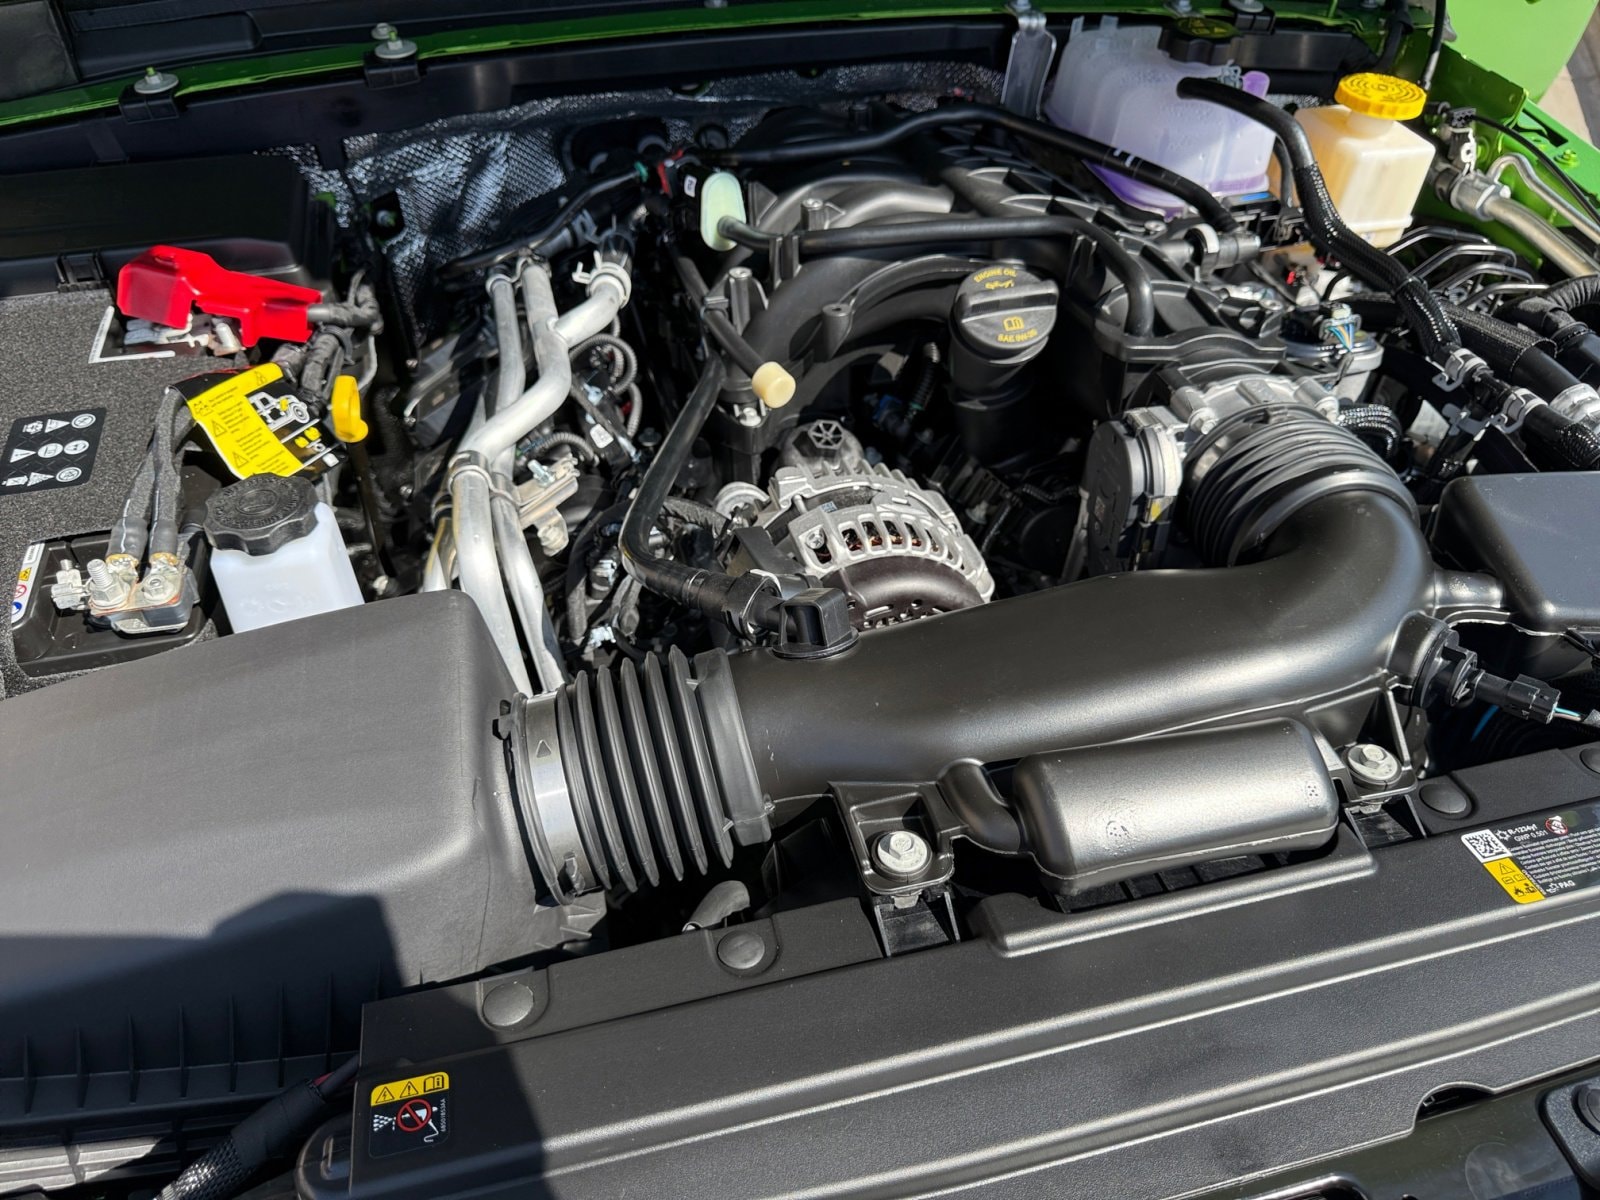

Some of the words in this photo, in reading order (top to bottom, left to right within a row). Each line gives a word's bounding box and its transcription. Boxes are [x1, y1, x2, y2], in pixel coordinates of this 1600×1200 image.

[974, 267, 1002, 282] ENGINE
[1003, 267, 1017, 278] OIL
[998, 333, 1015, 342] SAE
[1514, 833, 1530, 842] GWP
[1558, 880, 1576, 889] PAG
